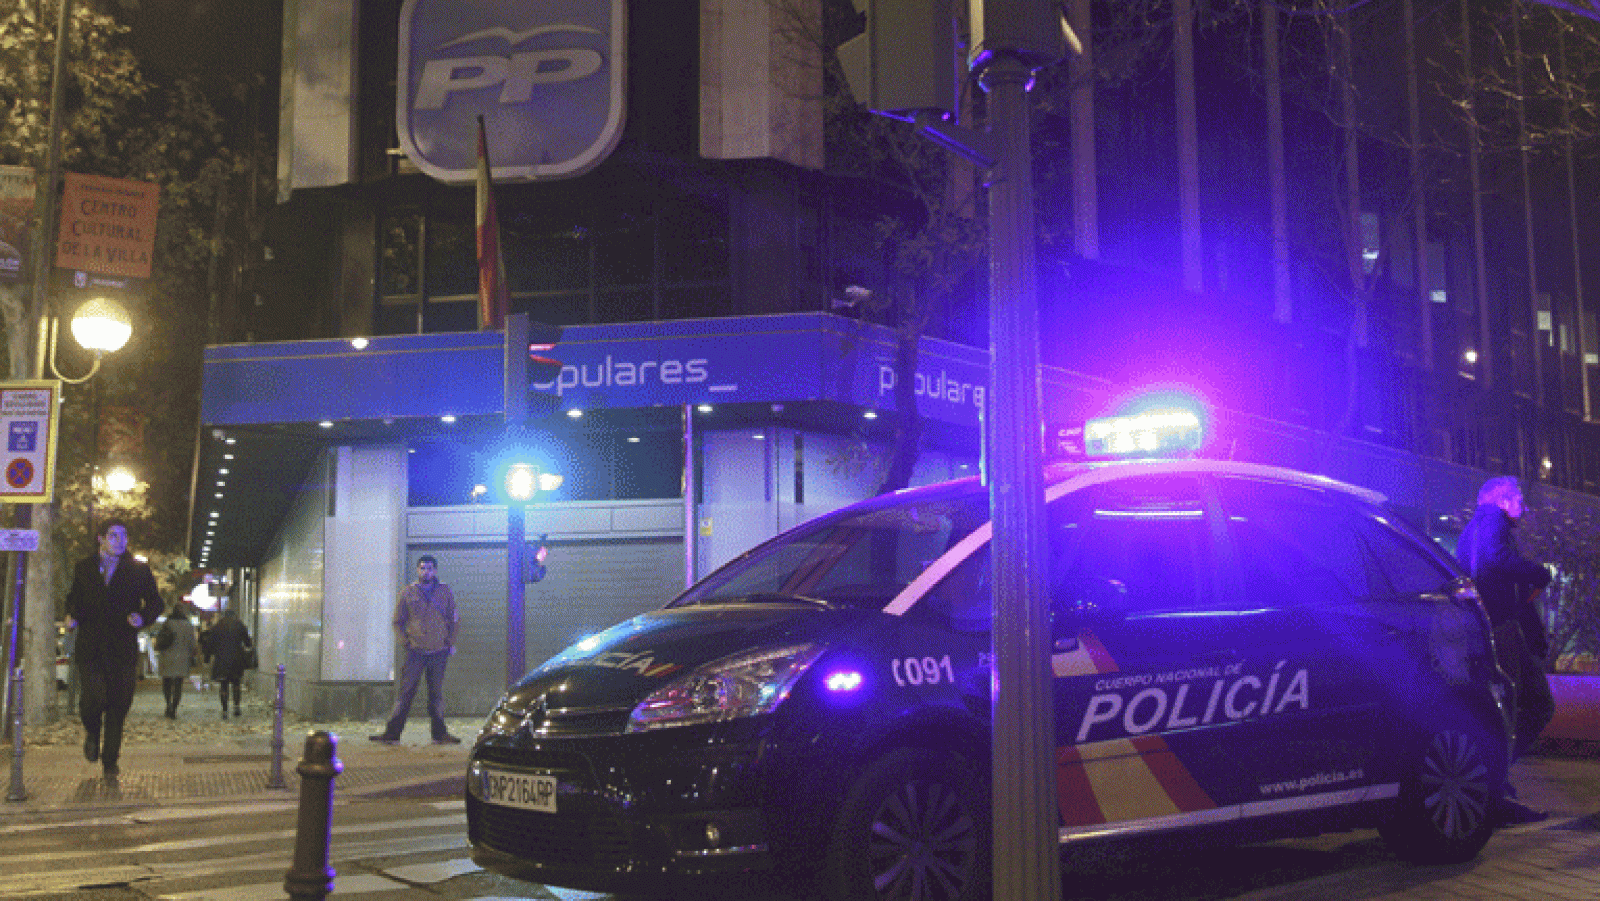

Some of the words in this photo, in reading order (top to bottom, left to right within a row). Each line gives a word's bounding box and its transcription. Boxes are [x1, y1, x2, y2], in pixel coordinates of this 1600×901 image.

[414, 49, 603, 109] PP
[80, 198, 138, 218] CENTRO
[1095, 673, 1153, 691] CUERPO
[1155, 666, 1220, 684] NACIONAL
[1075, 659, 1309, 742] POLICÍA
